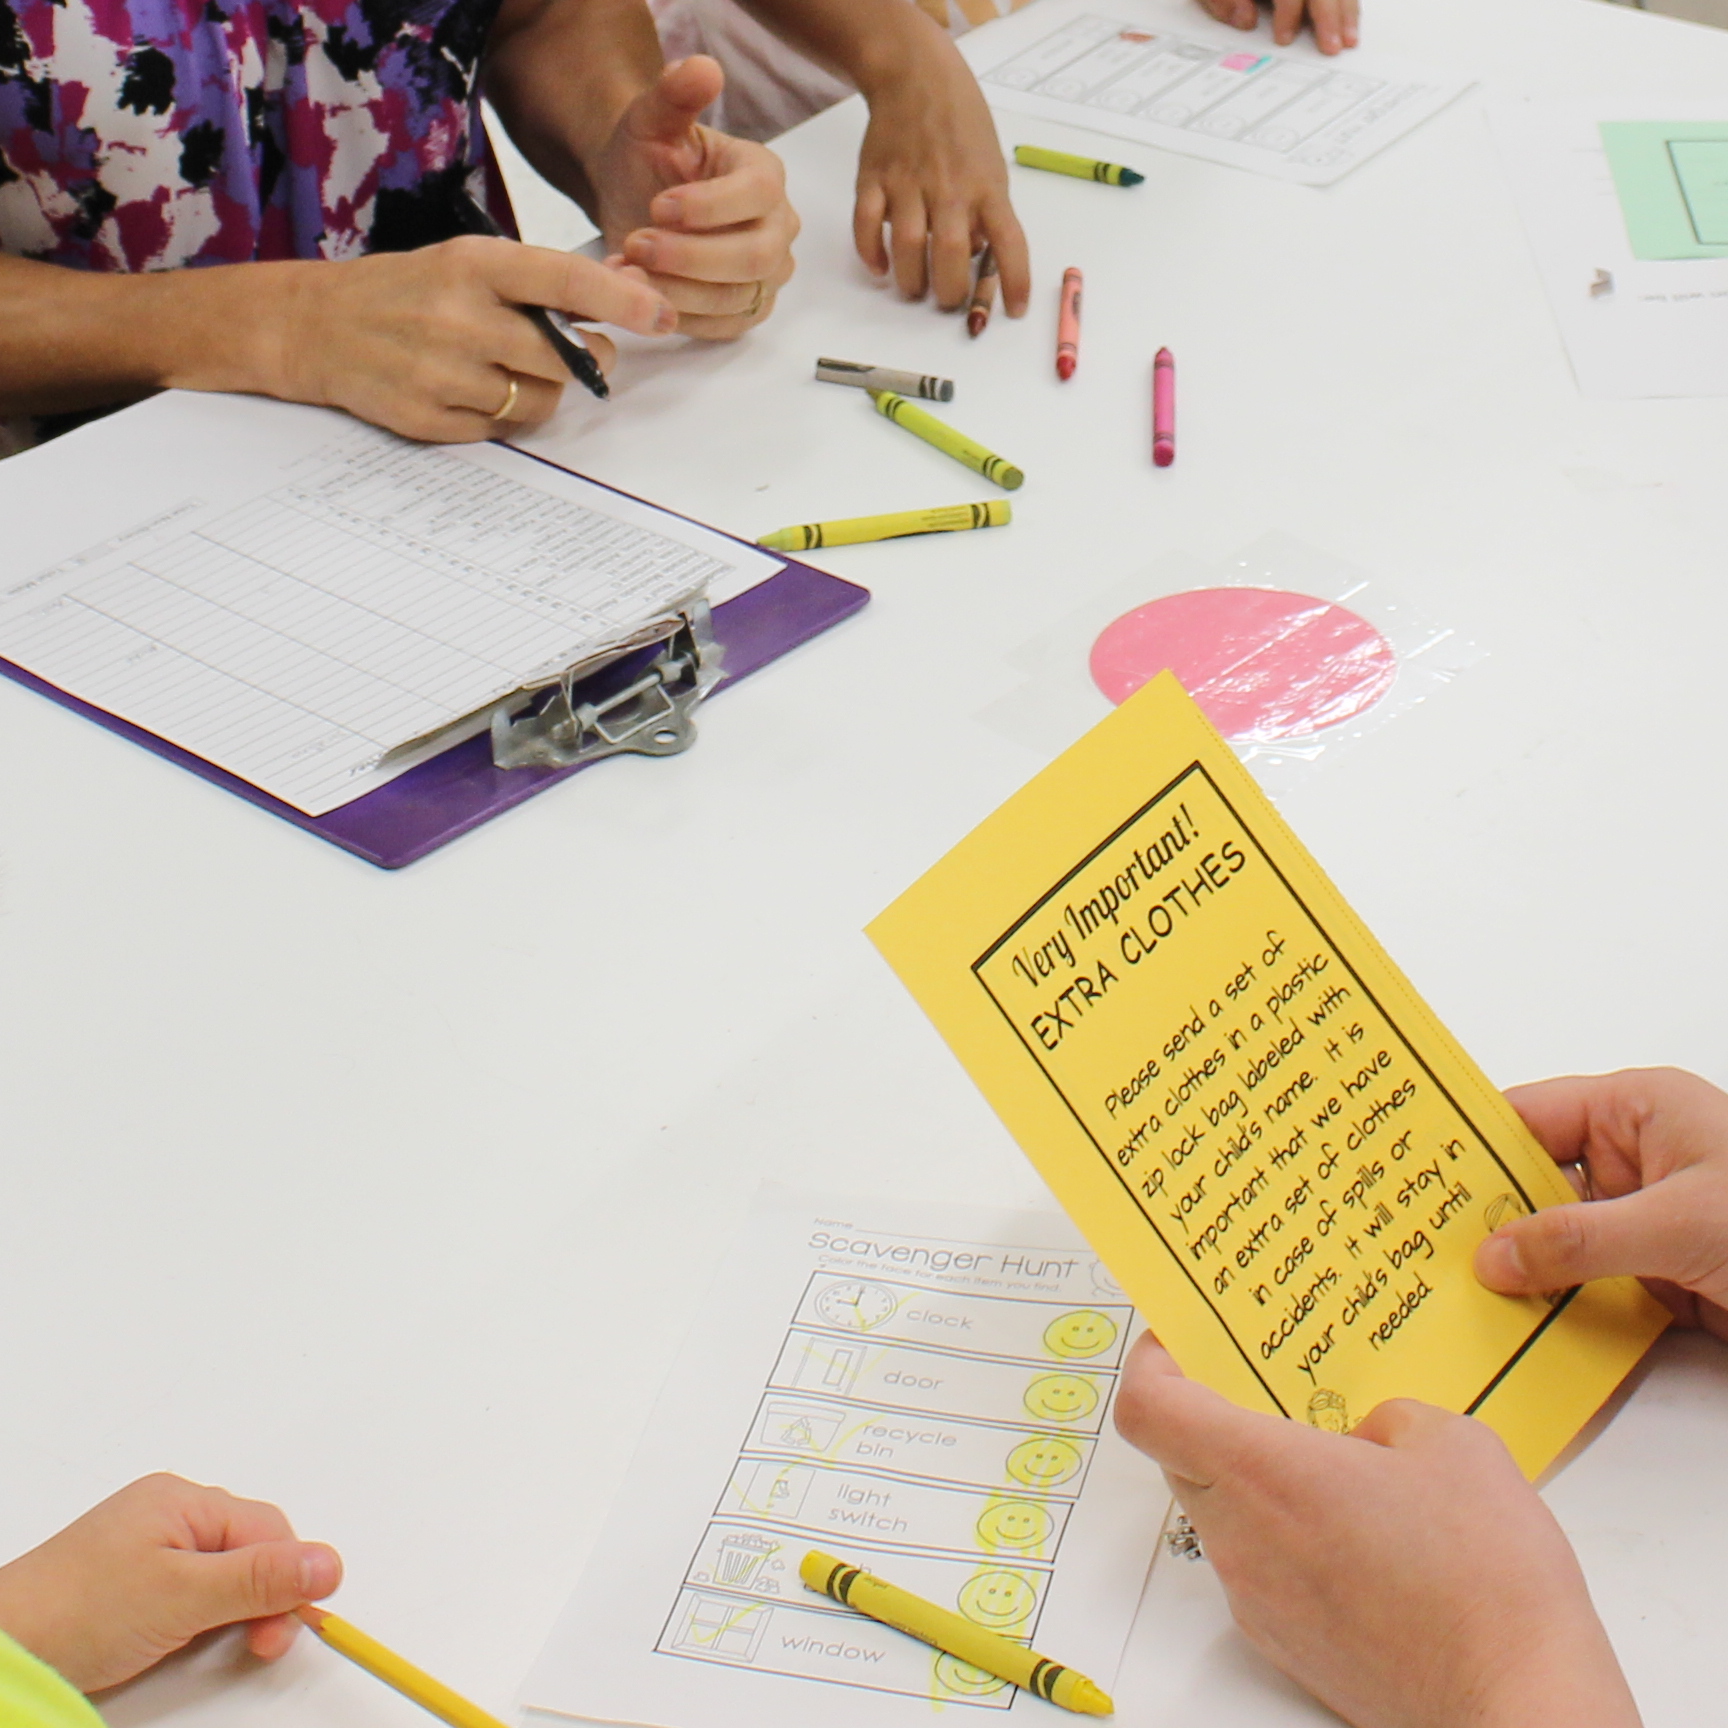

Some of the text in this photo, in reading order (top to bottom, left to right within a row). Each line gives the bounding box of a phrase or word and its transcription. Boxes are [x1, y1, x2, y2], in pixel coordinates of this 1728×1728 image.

[1011, 802, 1201, 988] Very Important!
[1029, 839, 1246, 1051] EXTRA CLOTHES
[1103, 928, 1286, 1120] Please send a set of
[1116, 952, 1329, 1167] extra clothes in a plastic
[1140, 984, 1352, 1199] zip lock bag labeled with
[1169, 1021, 1364, 1234] your child's name. It is
[1184, 1049, 1392, 1261] important that we have
[1213, 1077, 1416, 1295] an extra set of clothes
[808, 1231, 1079, 1280] Scavenger Hunt
[813, 1217, 854, 1231] Name
[881, 1262, 912, 1275] face
[935, 1271, 971, 1285] each
[973, 1275, 1003, 1287] item
[1006, 1280, 1031, 1292] you
[1247, 1128, 1412, 1307] in case of spills or
[1259, 1138, 1466, 1360] accidents. It will stay in
[1296, 1180, 1472, 1387] your child's bag until
[883, 1371, 944, 1391] door
[906, 1308, 973, 1330] clock
[828, 1506, 909, 1534] switch
[836, 1483, 893, 1509] light
[855, 1441, 894, 1459] bin
[862, 1423, 958, 1448] recycle
[781, 1635, 886, 1664] window
